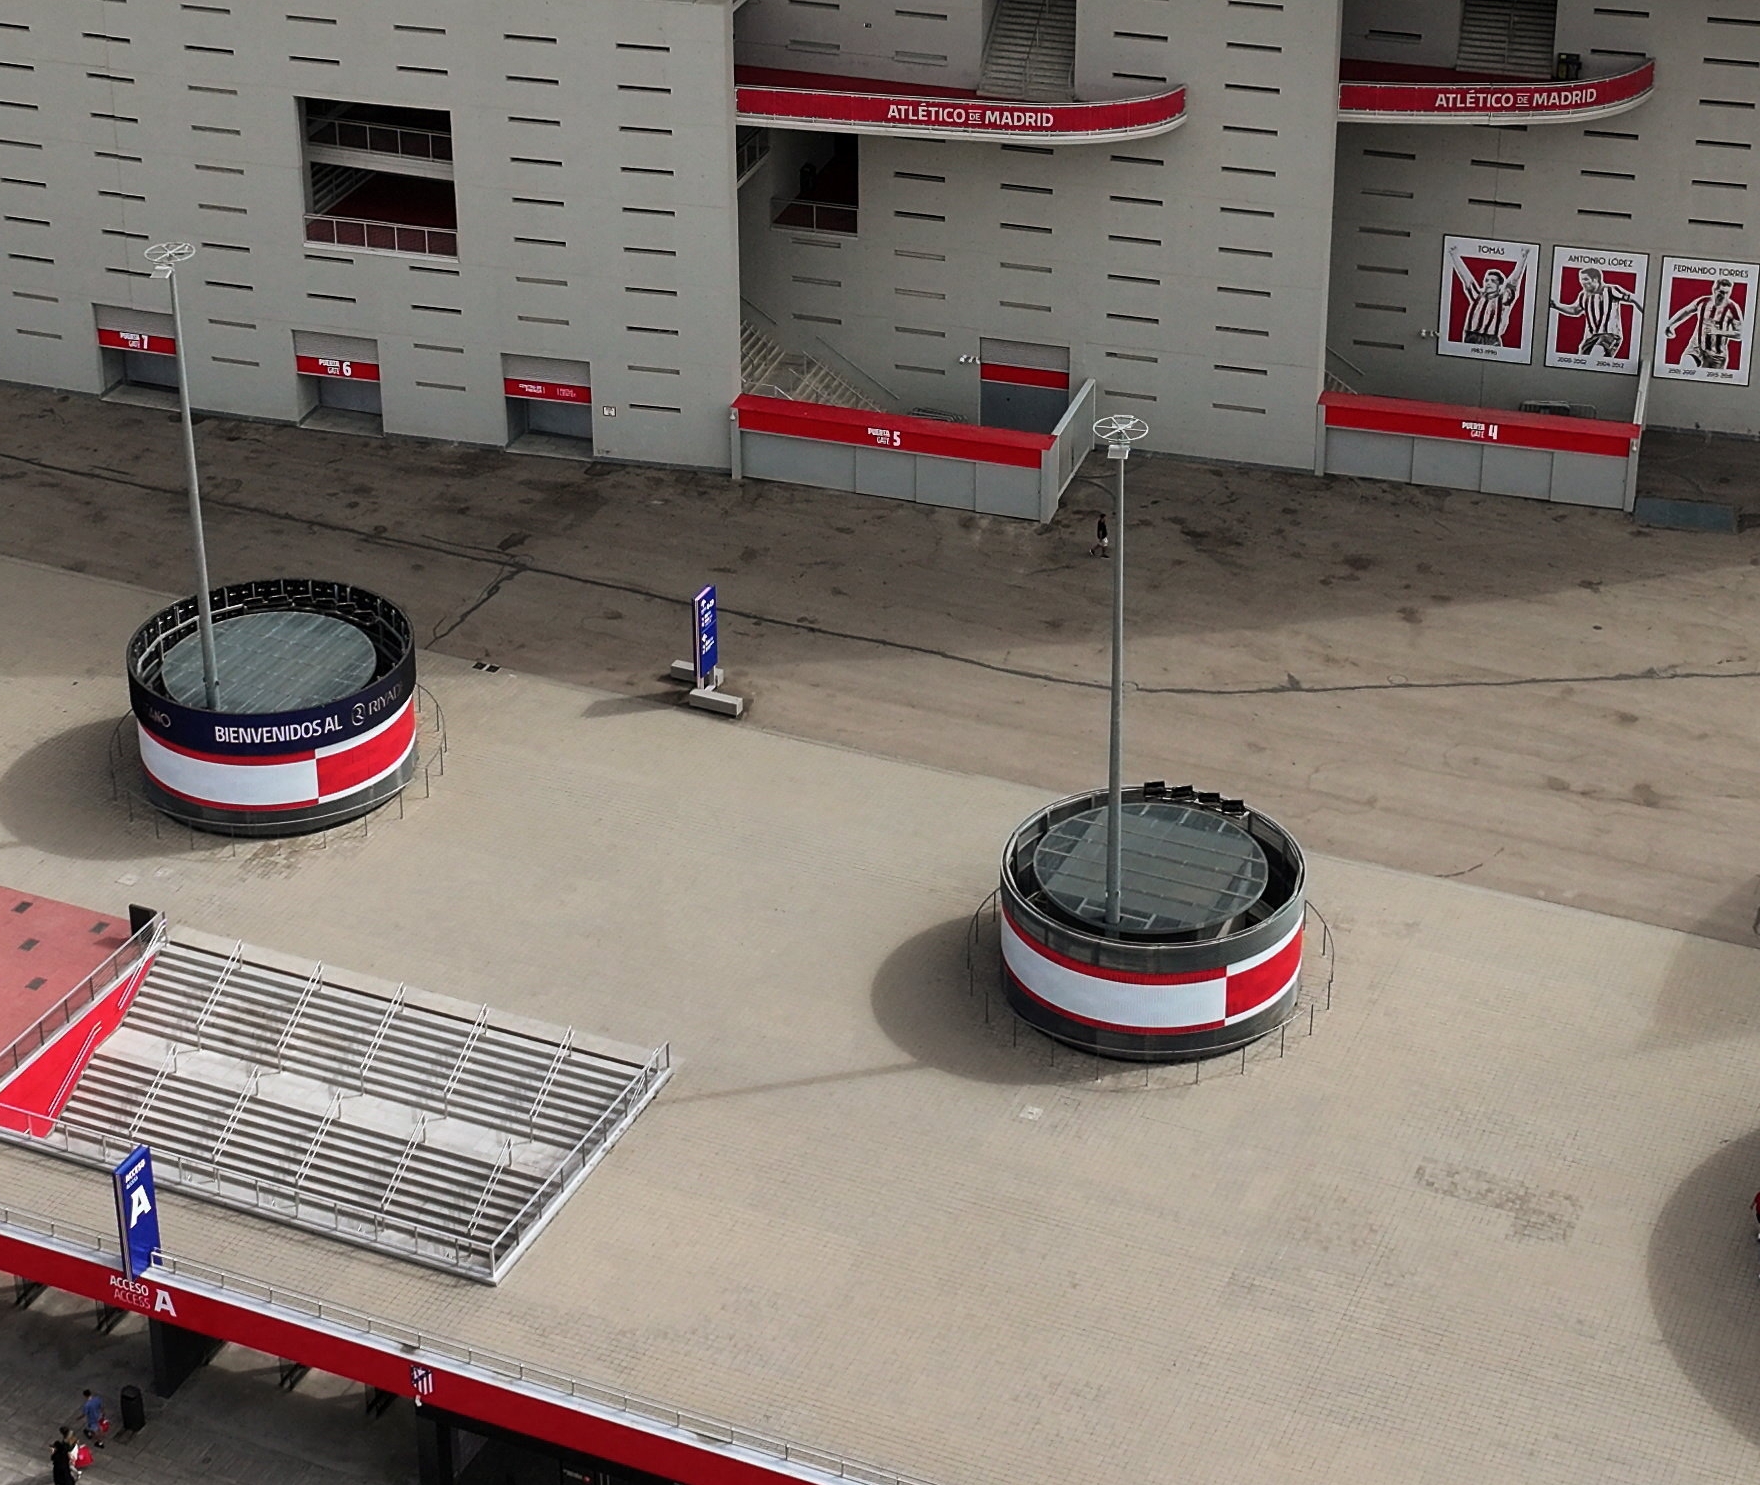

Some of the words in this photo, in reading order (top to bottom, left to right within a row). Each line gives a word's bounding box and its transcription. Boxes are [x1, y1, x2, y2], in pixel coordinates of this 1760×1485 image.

[1435, 90, 1514, 107] ATLÉTICO
[1517, 95, 1529, 105] DE
[1533, 88, 1597, 107] MADRID
[888, 103, 966, 123] ATLÉTICO
[969, 111, 982, 122] DE
[985, 110, 1054, 127] MADRID
[1568, 254, 1606, 266] ANTONIO
[1608, 256, 1634, 267] LÓPEZ
[1673, 264, 1717, 276] FERNANDO
[1718, 266, 1749, 278] TORRES
[141, 335, 148, 349] 7
[343, 361, 351, 377] 6
[893, 431, 901, 446] 5
[1488, 424, 1498, 440] 4
[215, 719, 322, 743] BIENVENIDOS
[324, 714, 343, 734] AL
[130, 1184, 152, 1229] A
[109, 1275, 149, 1296] ACCESO
[154, 1289, 177, 1317] A
[113, 1288, 151, 1310] ACCESS
